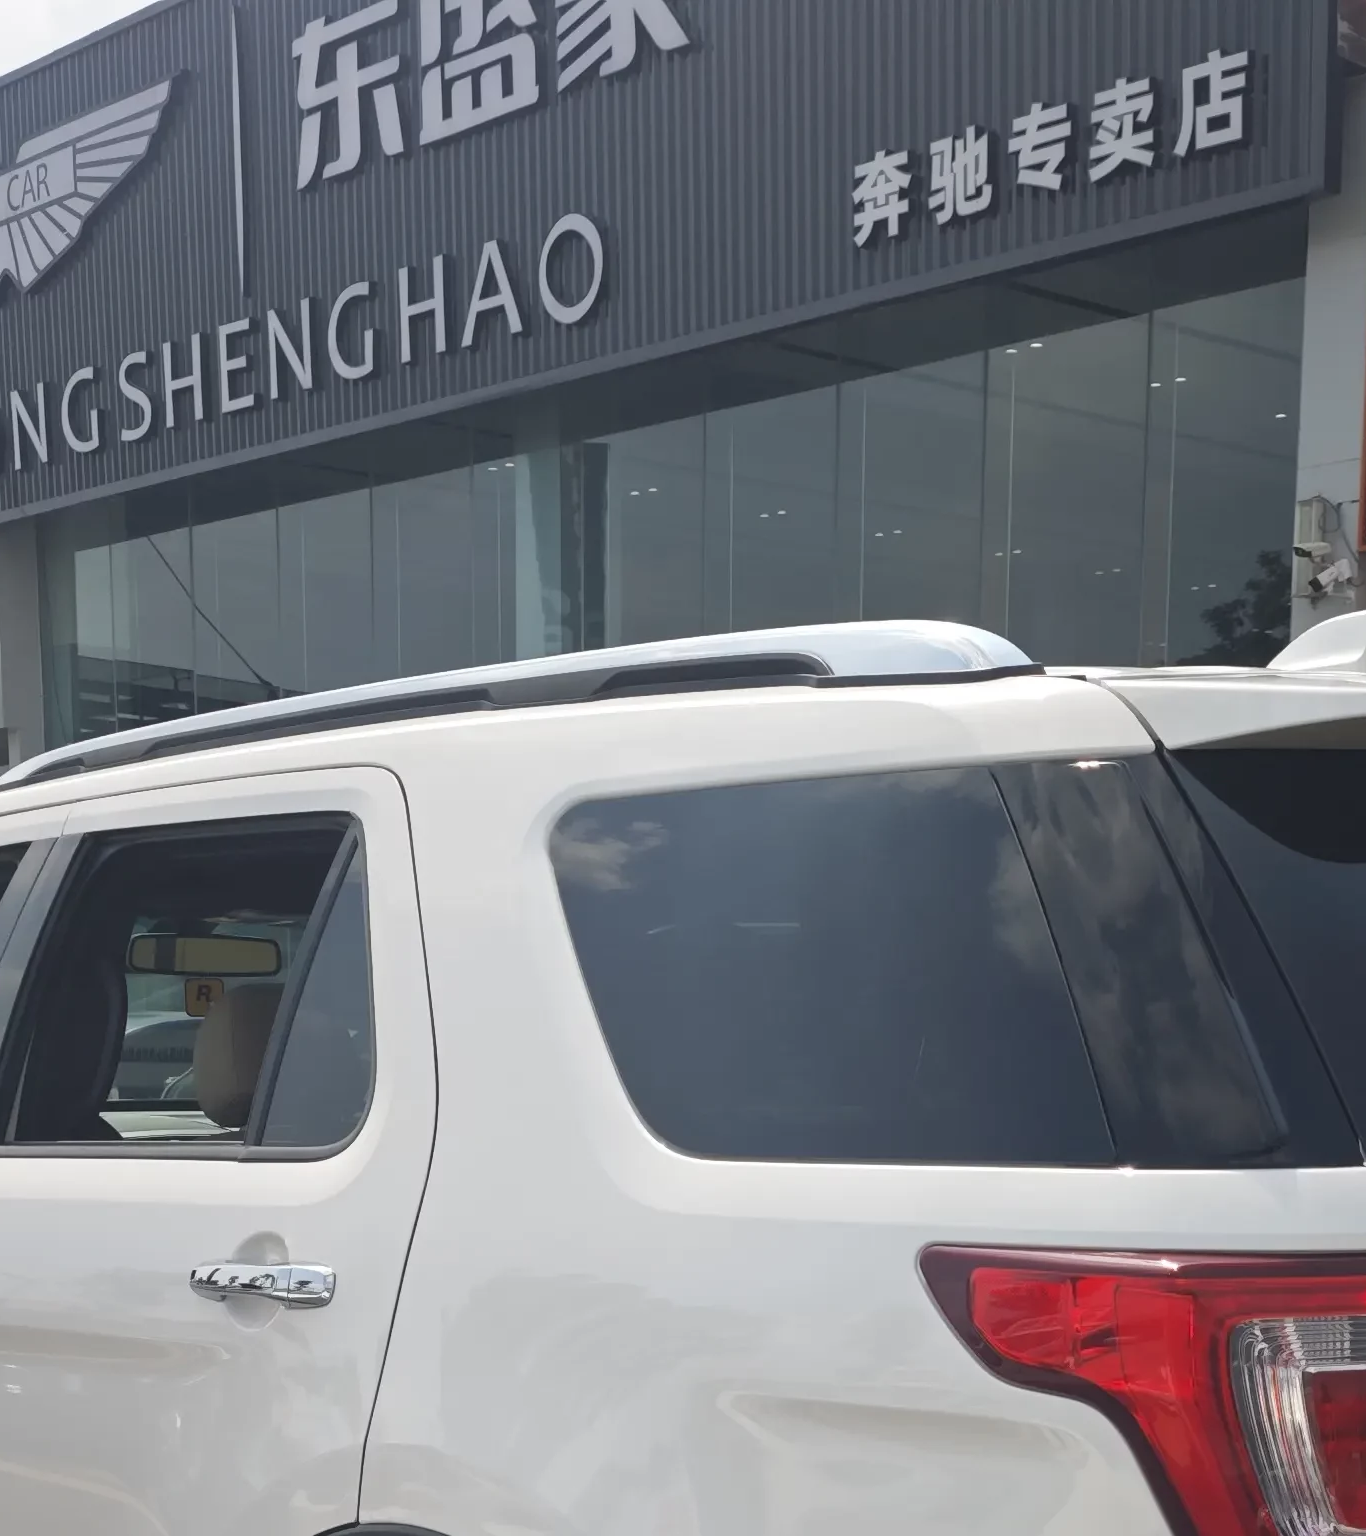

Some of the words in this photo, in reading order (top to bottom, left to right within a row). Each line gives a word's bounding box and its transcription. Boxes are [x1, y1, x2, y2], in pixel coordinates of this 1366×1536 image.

[6, 163, 51, 213] CAR
[851, 49, 1249, 249] 奔驰专卖店
